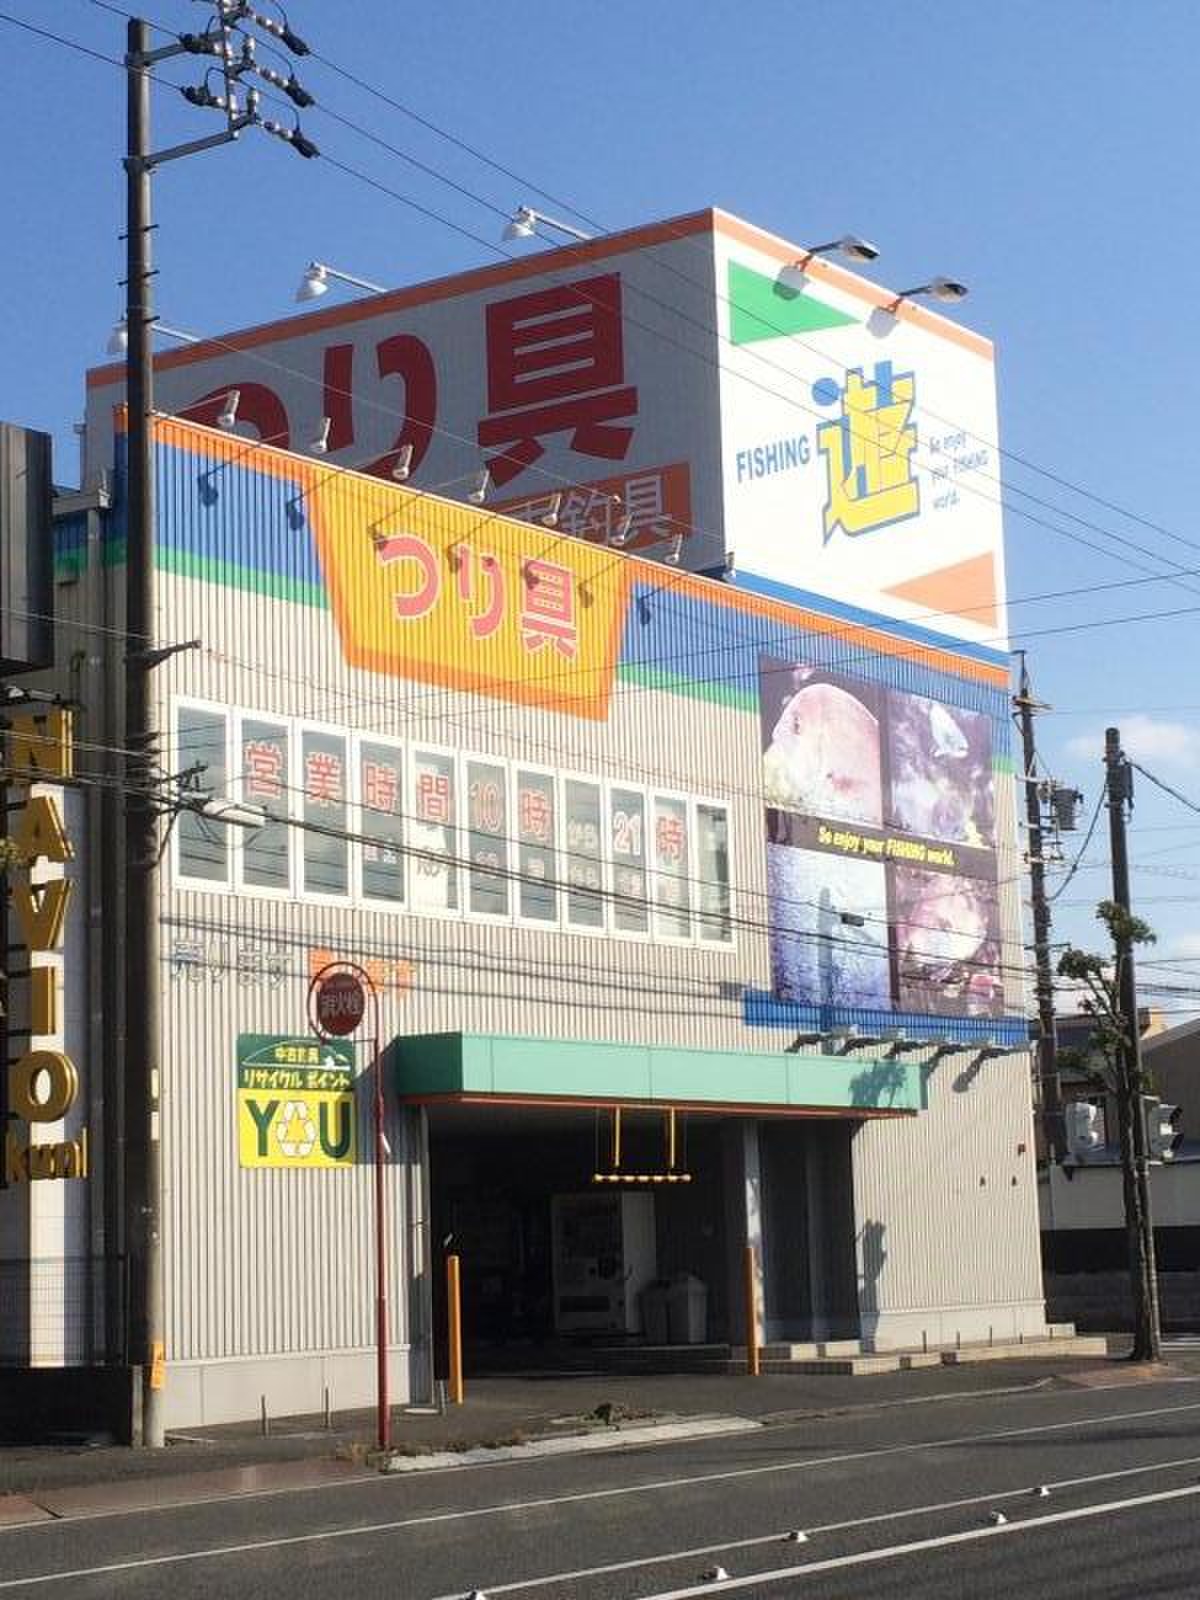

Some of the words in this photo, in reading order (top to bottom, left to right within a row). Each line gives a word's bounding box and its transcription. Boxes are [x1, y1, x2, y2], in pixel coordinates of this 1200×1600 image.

[736, 434, 811, 484] FISHING
[376, 533, 577, 659] つり具
[244, 1069, 304, 1089] リサイクル
[307, 1069, 351, 1089] ポイント
